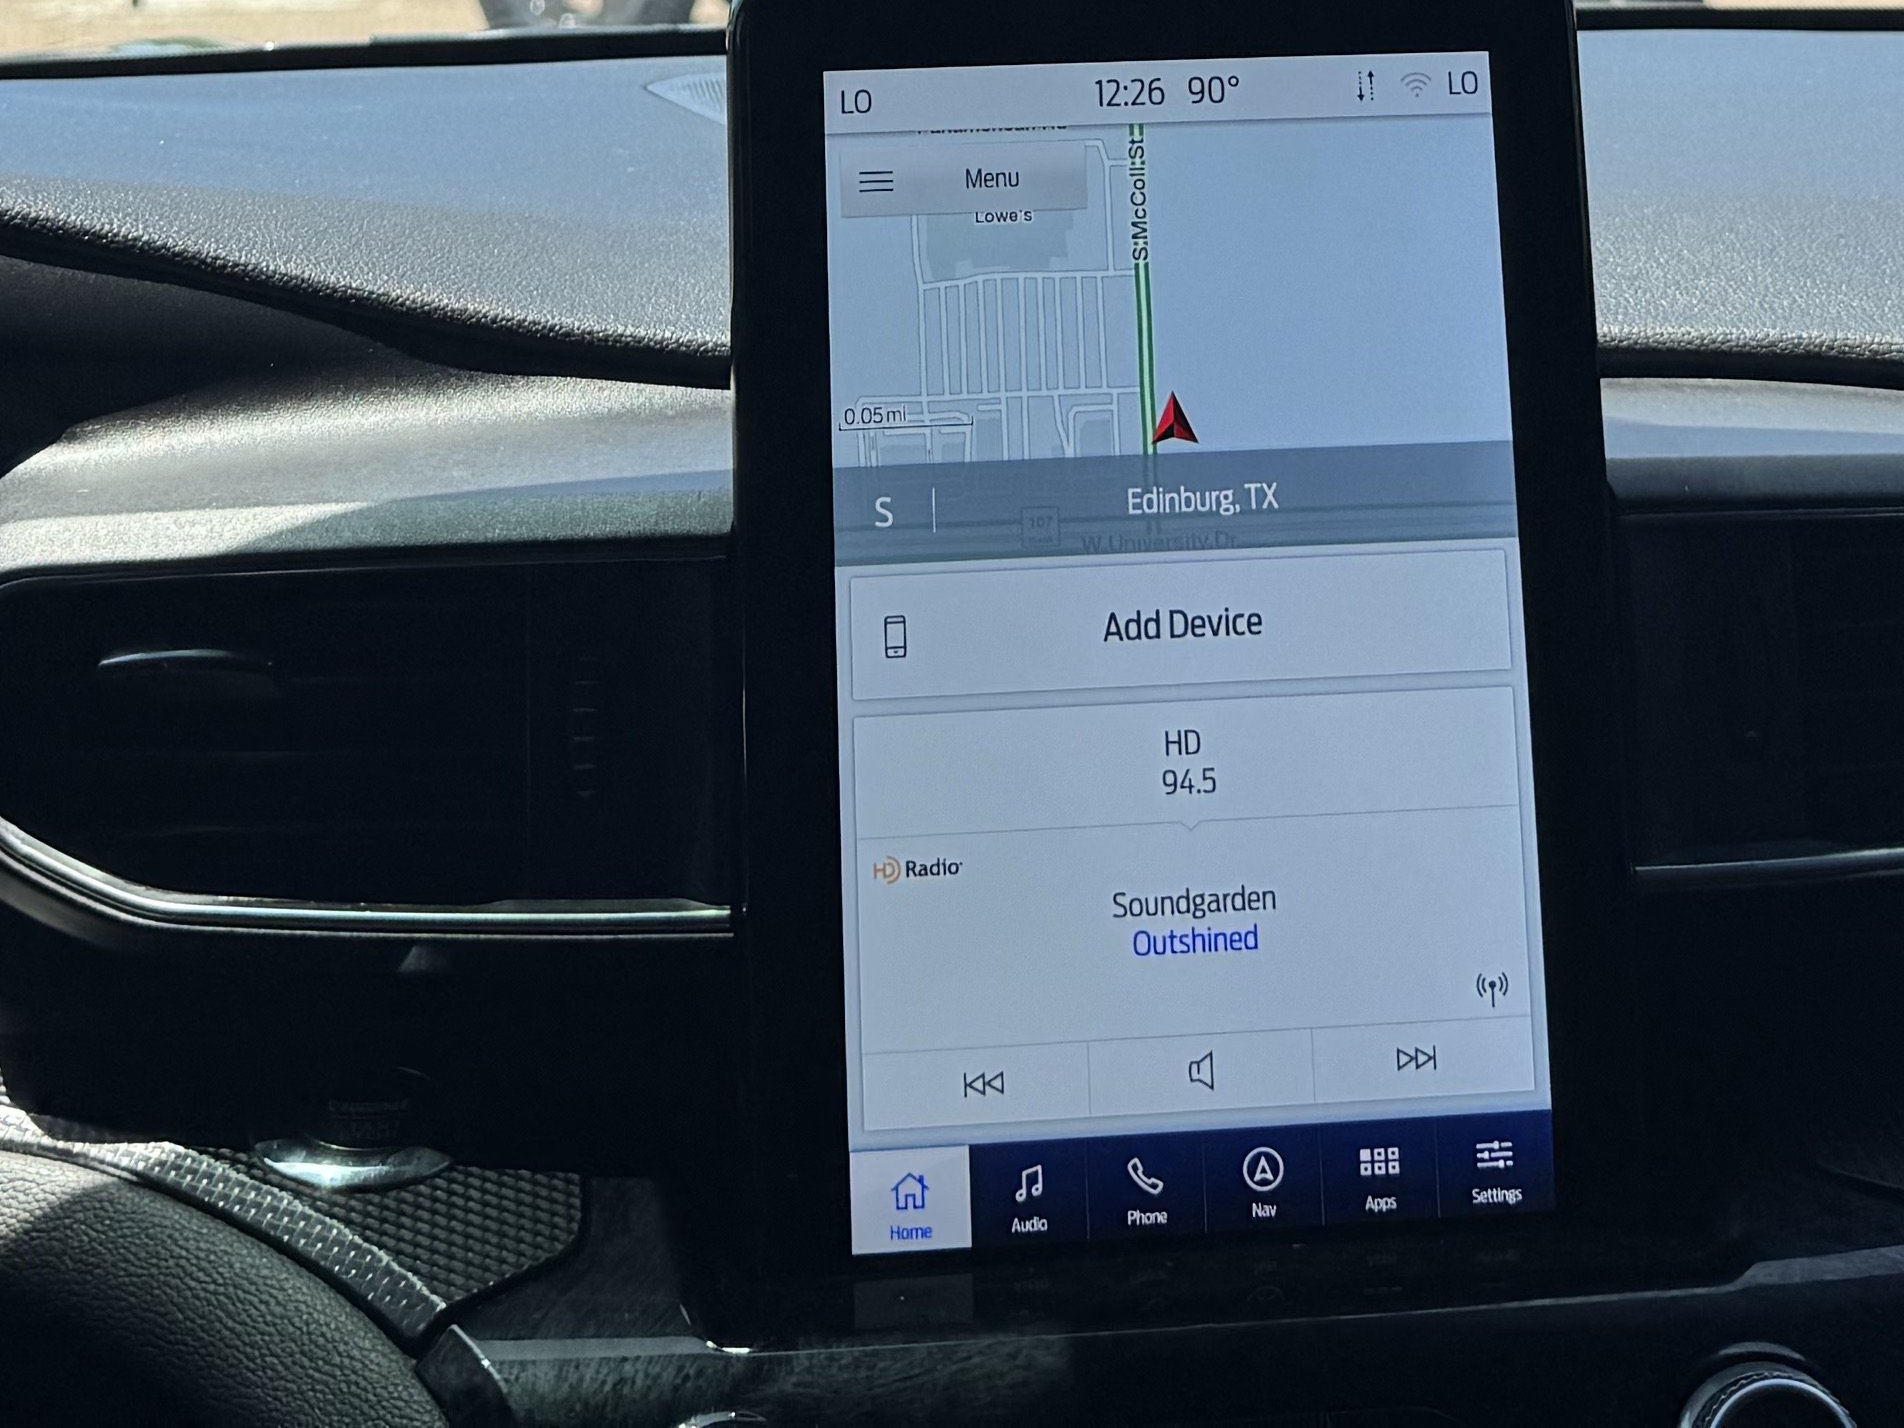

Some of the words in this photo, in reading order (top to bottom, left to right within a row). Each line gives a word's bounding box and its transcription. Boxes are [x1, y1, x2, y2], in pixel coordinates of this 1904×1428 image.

[1095, 78, 1166, 108] 12:26
[1187, 74, 1241, 105] 90°
[1447, 70, 1479, 96] LO
[840, 89, 873, 115] LO
[1128, 136, 1144, 160] St
[965, 167, 1020, 190] Menu
[1129, 166, 1147, 240] McColl
[1127, 485, 1241, 516] Edinburg,
[1243, 481, 1280, 511] TX
[874, 496, 894, 528] S
[1102, 608, 1162, 643] Add
[1169, 606, 1264, 641] Device
[1163, 728, 1203, 758] HD
[1161, 767, 1218, 798] 94.5
[1111, 883, 1278, 923] Soundgarden
[1131, 923, 1259, 959] Outshined
[1364, 1194, 1397, 1214] Apps
[1471, 1184, 1523, 1206] Settings
[1127, 1206, 1169, 1227] Phone
[1251, 1201, 1277, 1219] Nav
[890, 1222, 933, 1242] Home
[1010, 1215, 1048, 1234] Audio
